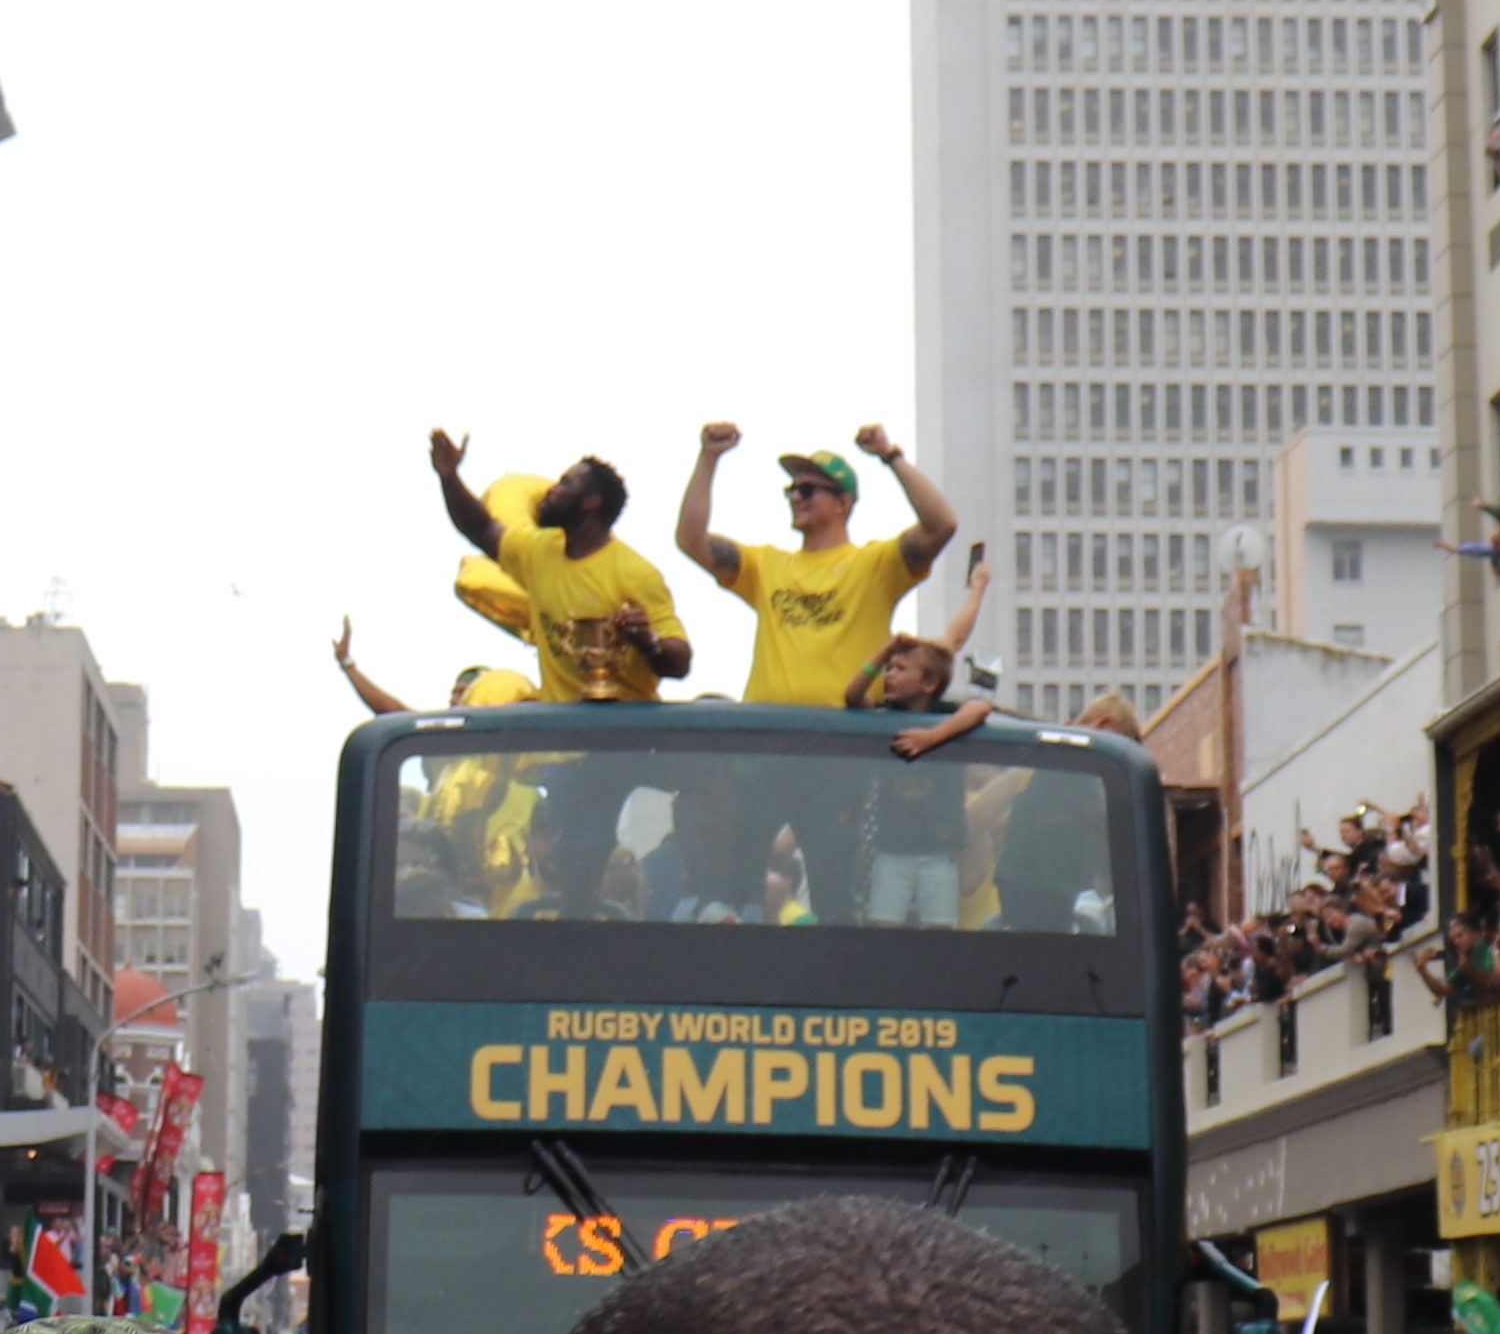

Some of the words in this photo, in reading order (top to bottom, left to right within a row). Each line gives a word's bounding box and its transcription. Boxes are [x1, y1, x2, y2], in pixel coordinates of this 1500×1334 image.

[547, 1009, 664, 1041] RUGBY
[669, 1012, 796, 1045] WORLD
[802, 1015, 869, 1046] CUP
[877, 1016, 958, 1048] 2019
[470, 1043, 1036, 1133] CHAMPIONS
[1477, 1141, 1500, 1216] 25
